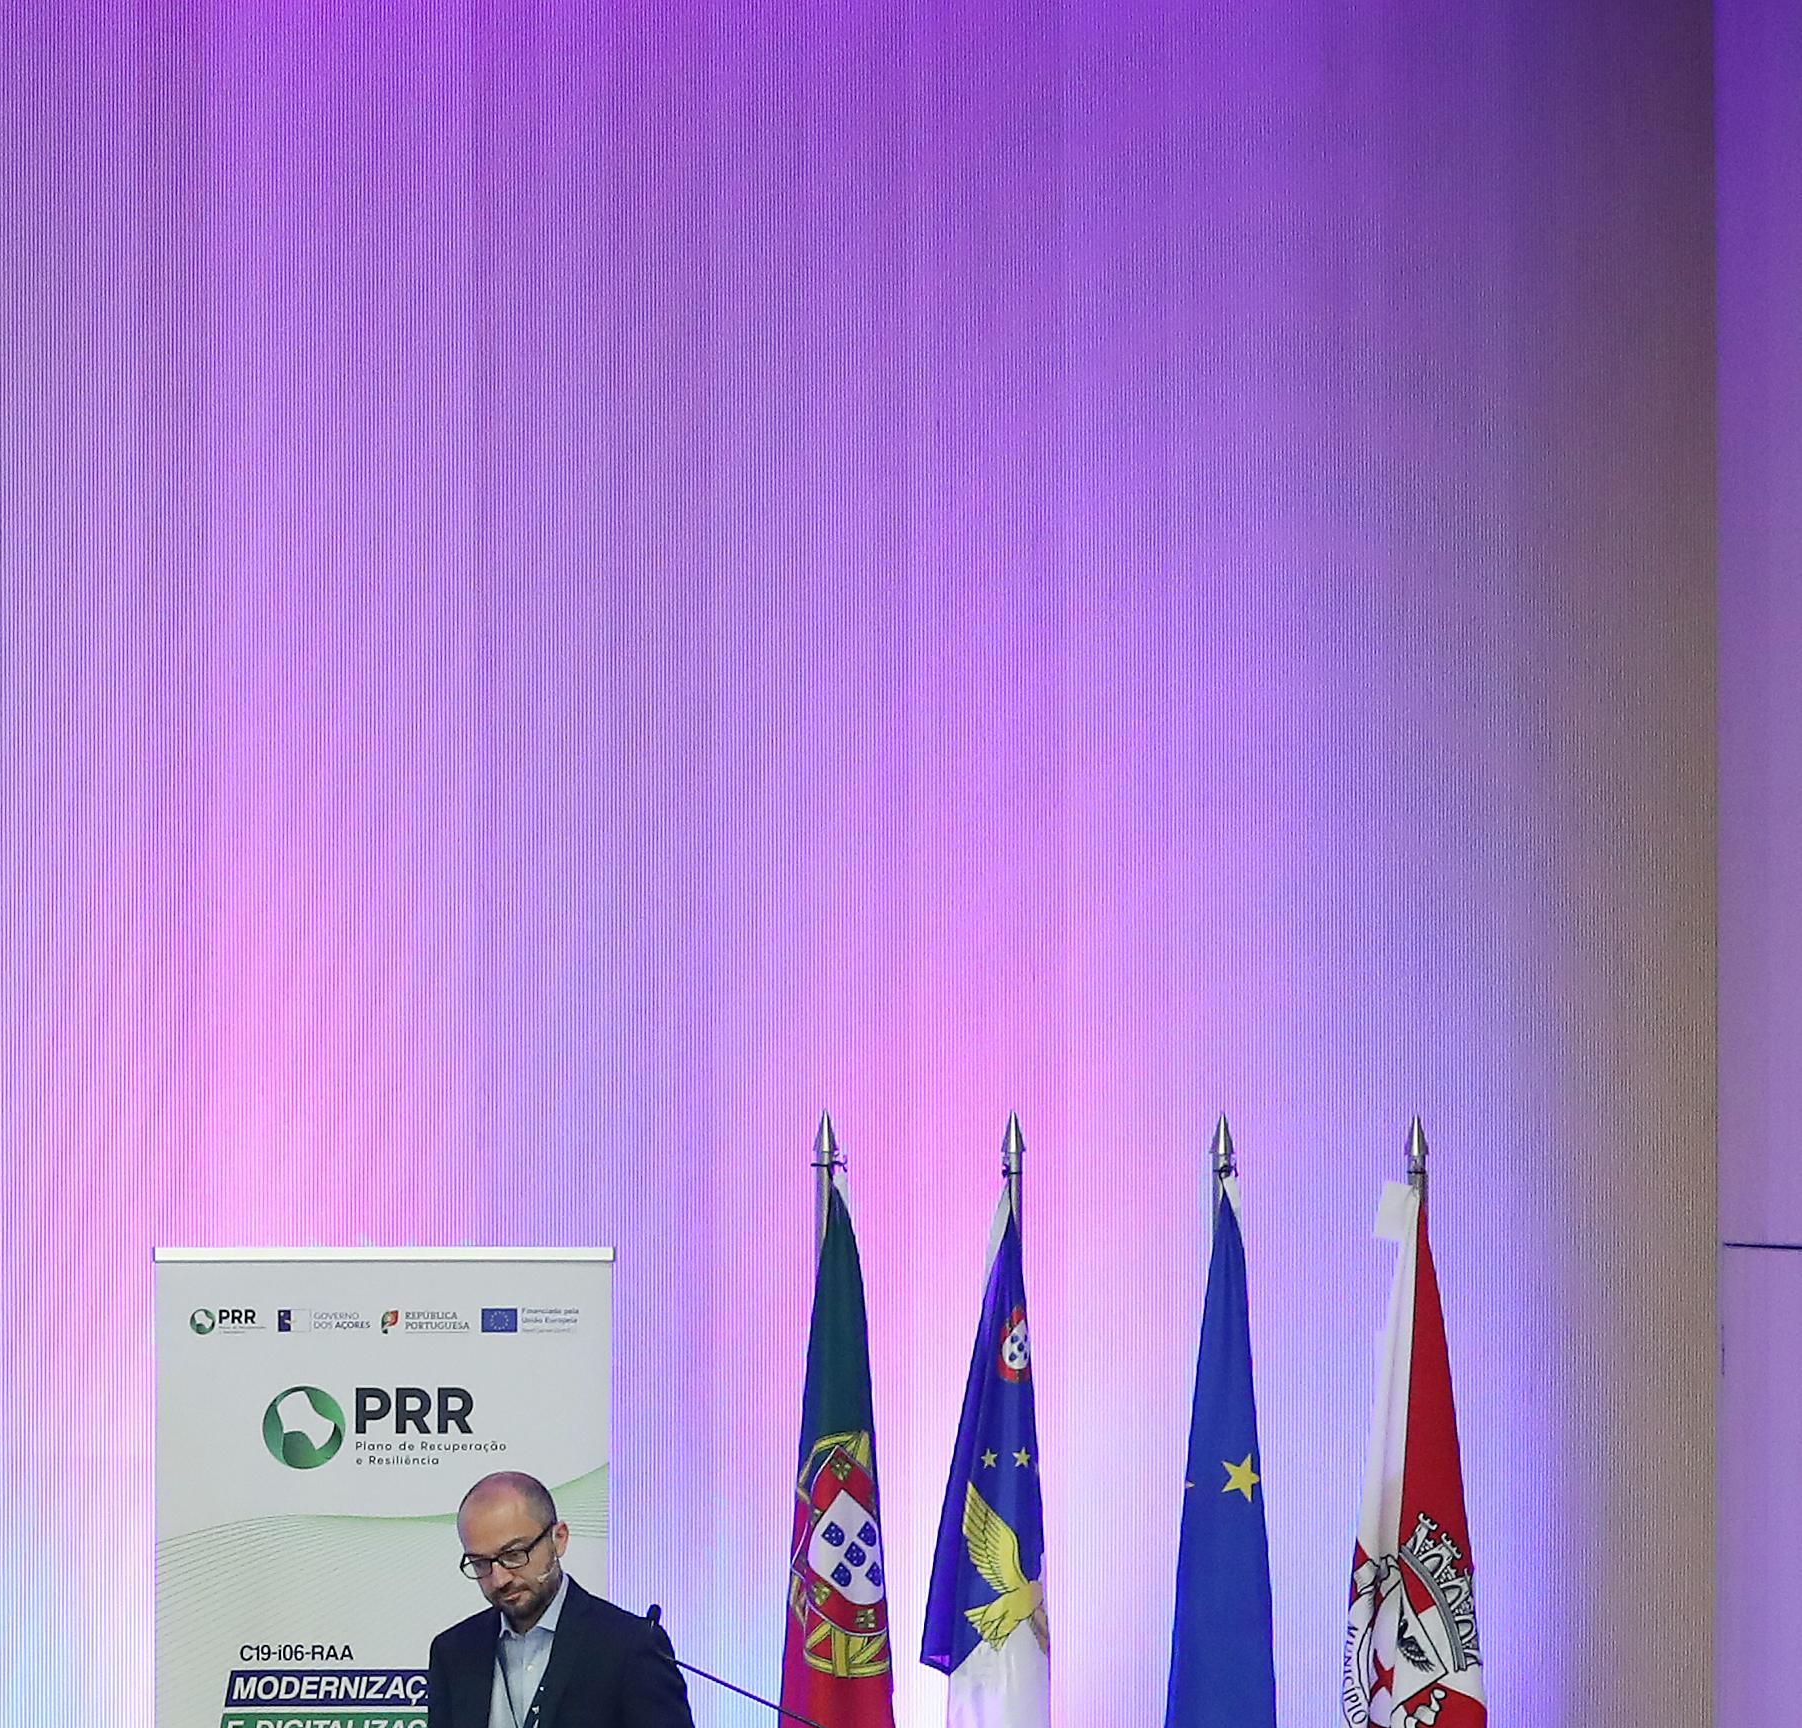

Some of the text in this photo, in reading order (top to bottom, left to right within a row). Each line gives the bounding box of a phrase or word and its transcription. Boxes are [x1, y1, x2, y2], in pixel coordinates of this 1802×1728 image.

[219, 1310, 256, 1324] PRR
[313, 1312, 359, 1320] GOVERNO
[405, 1310, 457, 1319] REPÚBLICA
[335, 1321, 371, 1330] AÇORES
[405, 1321, 470, 1330] PORTUGUESA
[356, 1388, 473, 1434] PRR
[356, 1441, 506, 1453] Plano de Recuperação
[369, 1455, 439, 1465] Resiliência
[240, 1645, 353, 1661] C19-i06-RAA
[232, 1676, 428, 1705] MODERNIZAÇ
